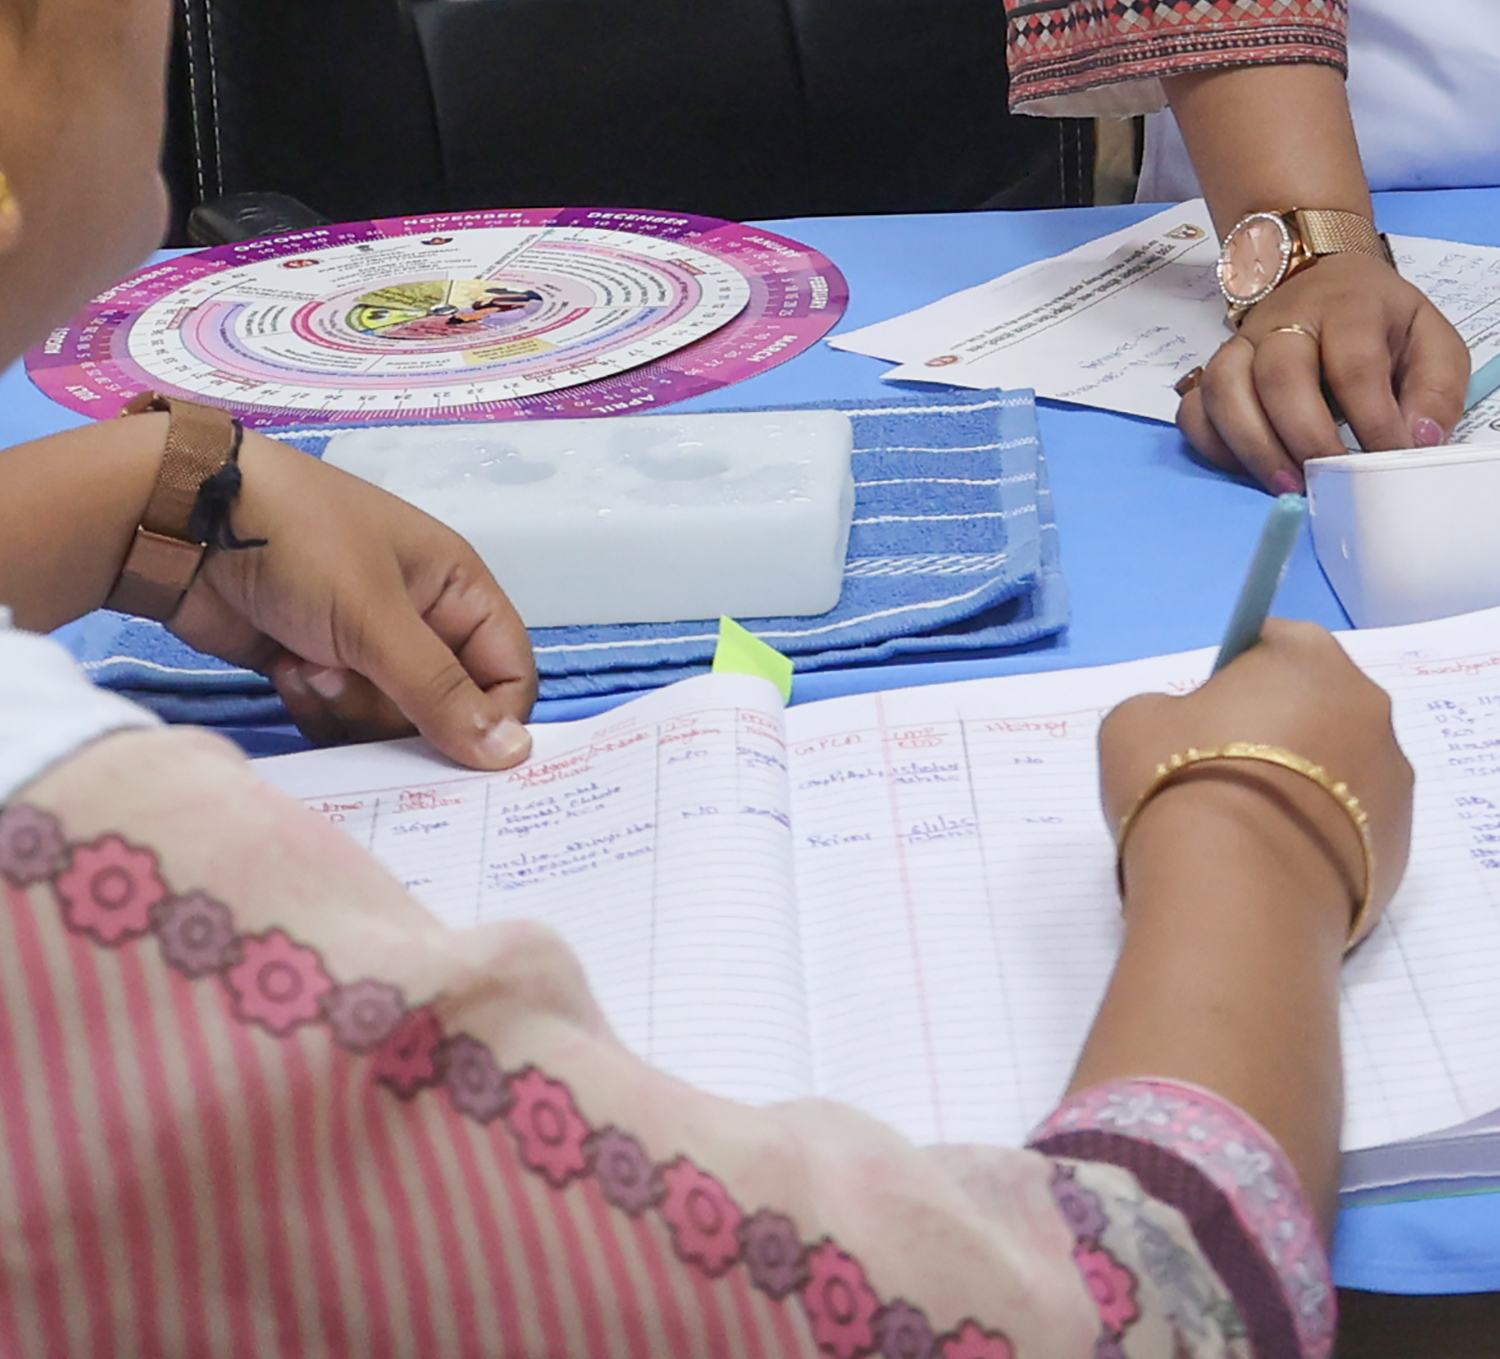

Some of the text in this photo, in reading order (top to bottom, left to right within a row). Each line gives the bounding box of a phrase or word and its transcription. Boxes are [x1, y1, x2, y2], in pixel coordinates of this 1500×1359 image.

[403, 212, 524, 226] NOVEMBER
[587, 211, 690, 226] DECEMBER
[233, 229, 330, 252] OCTOBER
[742, 235, 802, 259] JANUARY
[90, 265, 178, 304] SEPTEMBER
[747, 334, 800, 364] MARCH
[63, 385, 102, 404] JULY
[591, 394, 656, 414] APRIL
